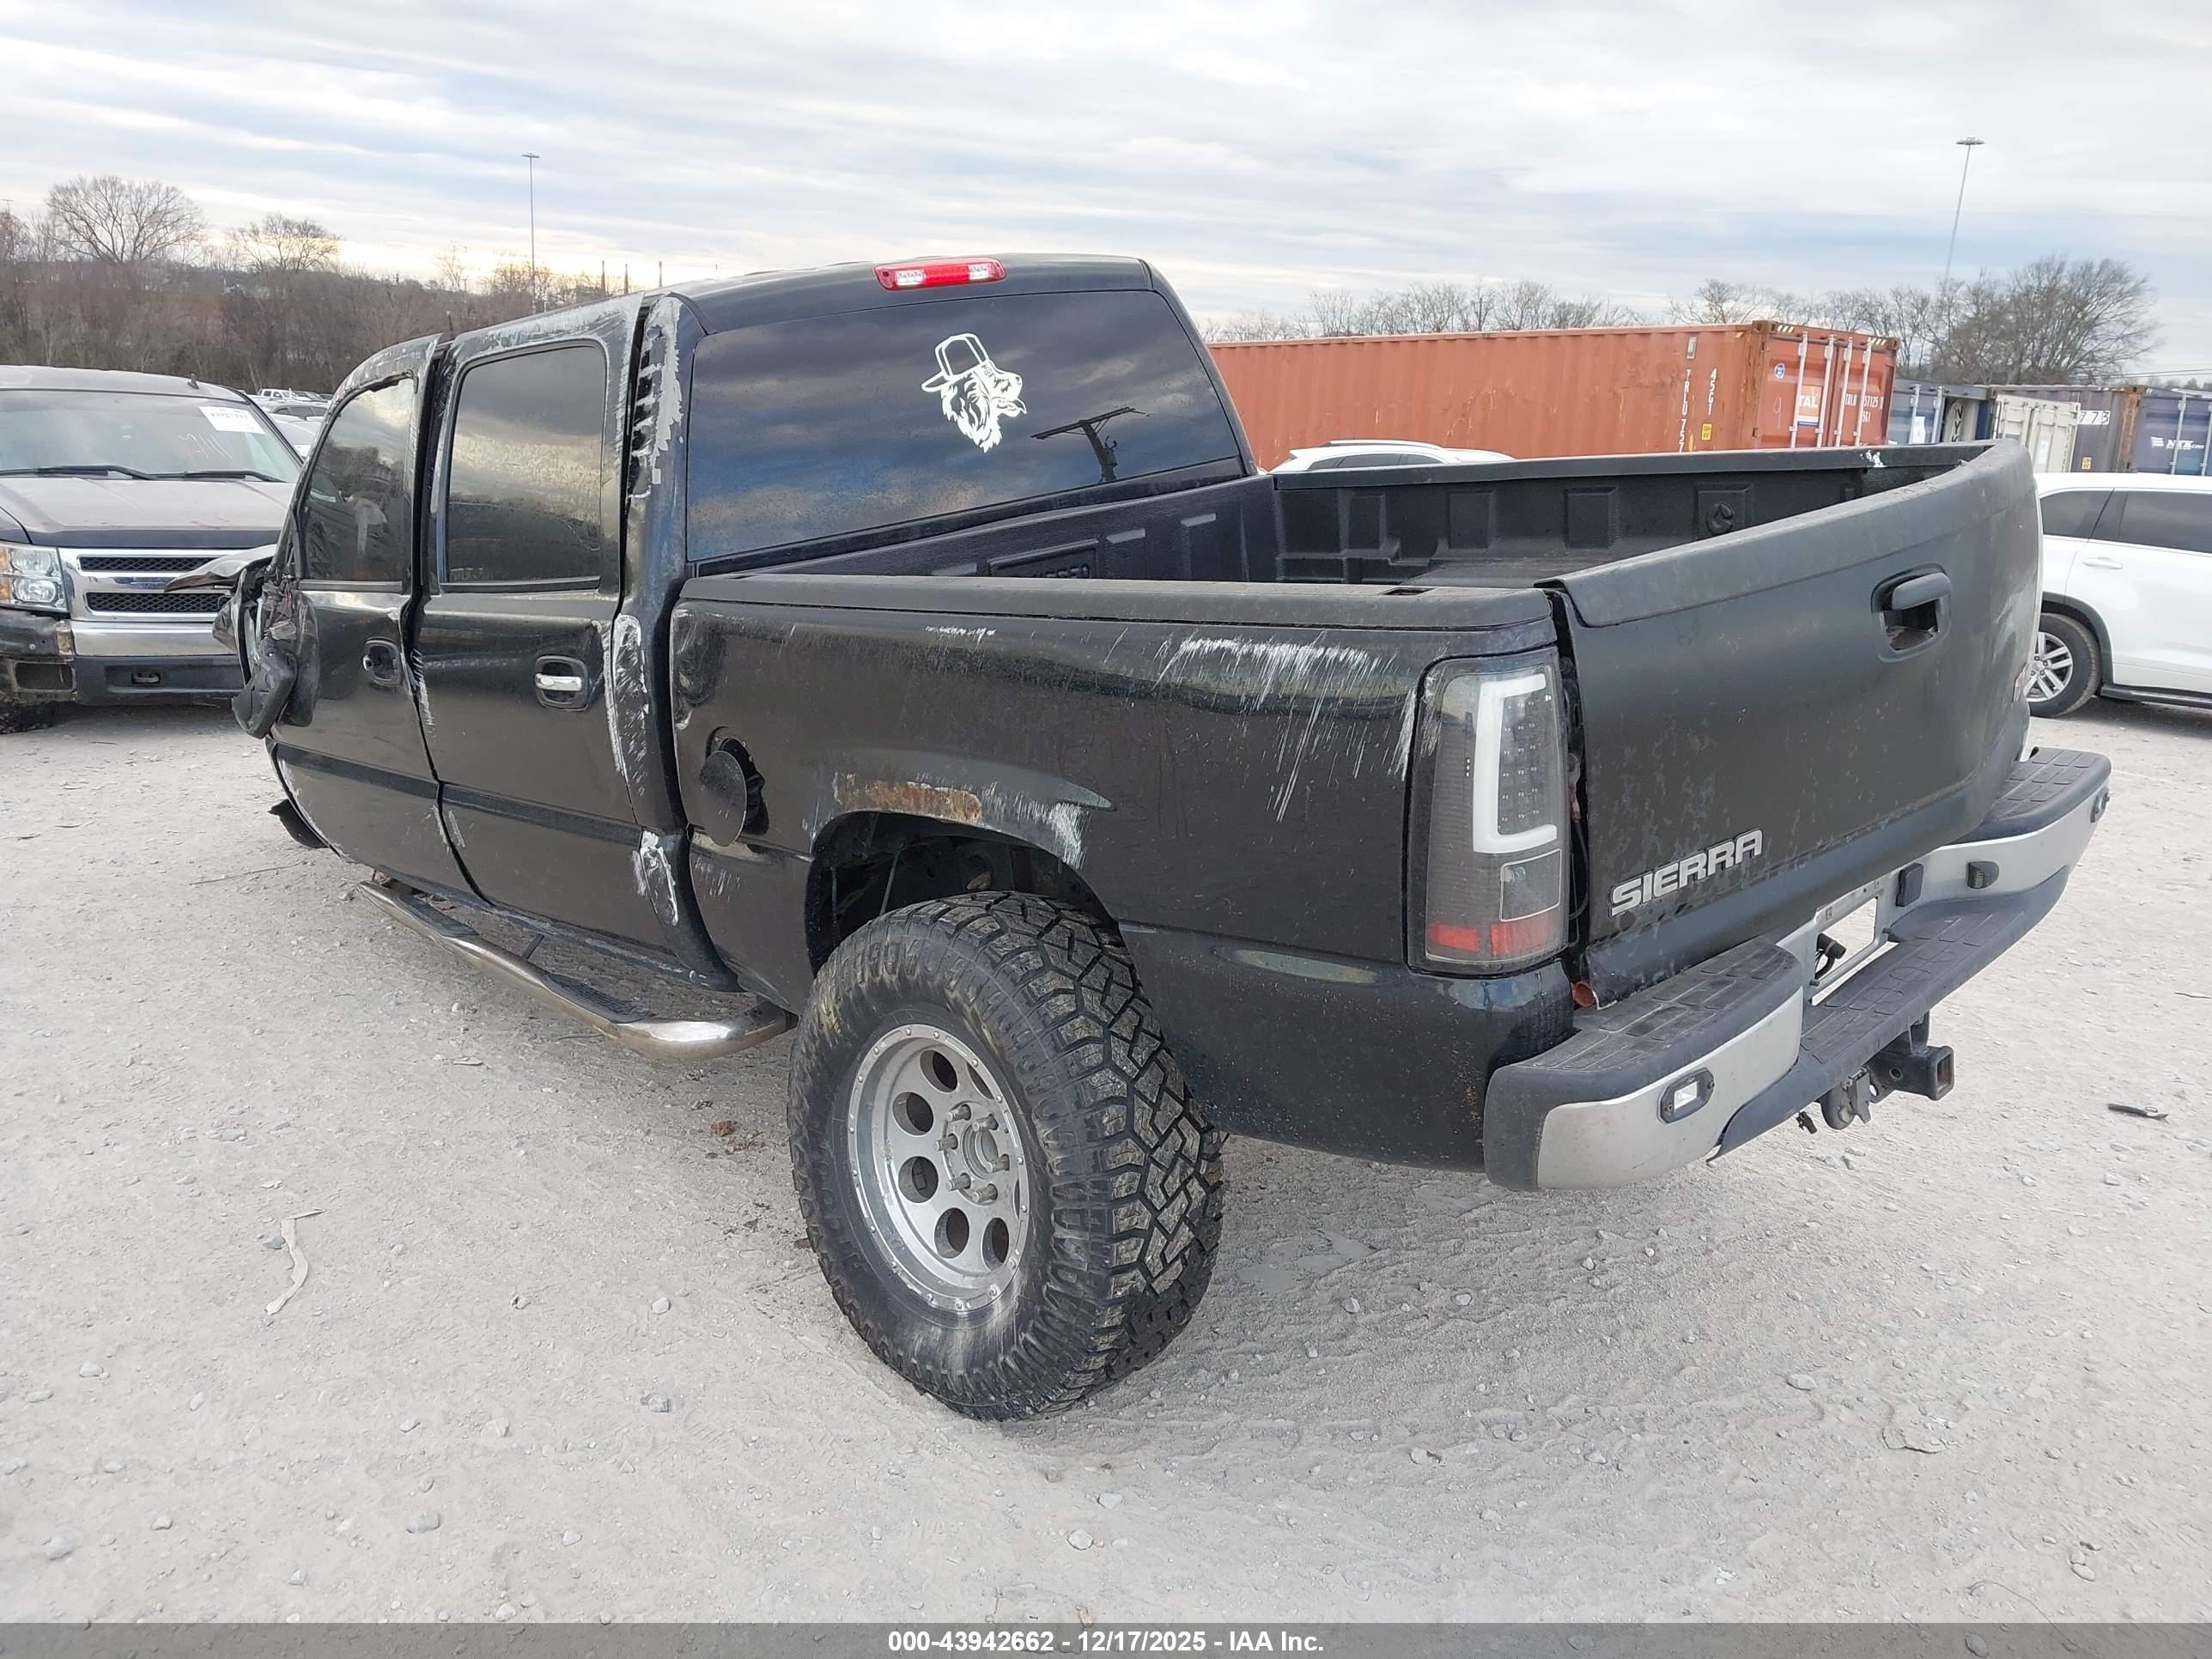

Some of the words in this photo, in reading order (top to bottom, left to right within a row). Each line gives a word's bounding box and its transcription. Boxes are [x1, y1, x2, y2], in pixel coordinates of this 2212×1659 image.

[1681, 369, 1692, 416] TRLU
[1799, 393, 1818, 408] TAL
[2166, 439, 2194, 450] NYK
[1609, 828, 1763, 918] SIERRA
